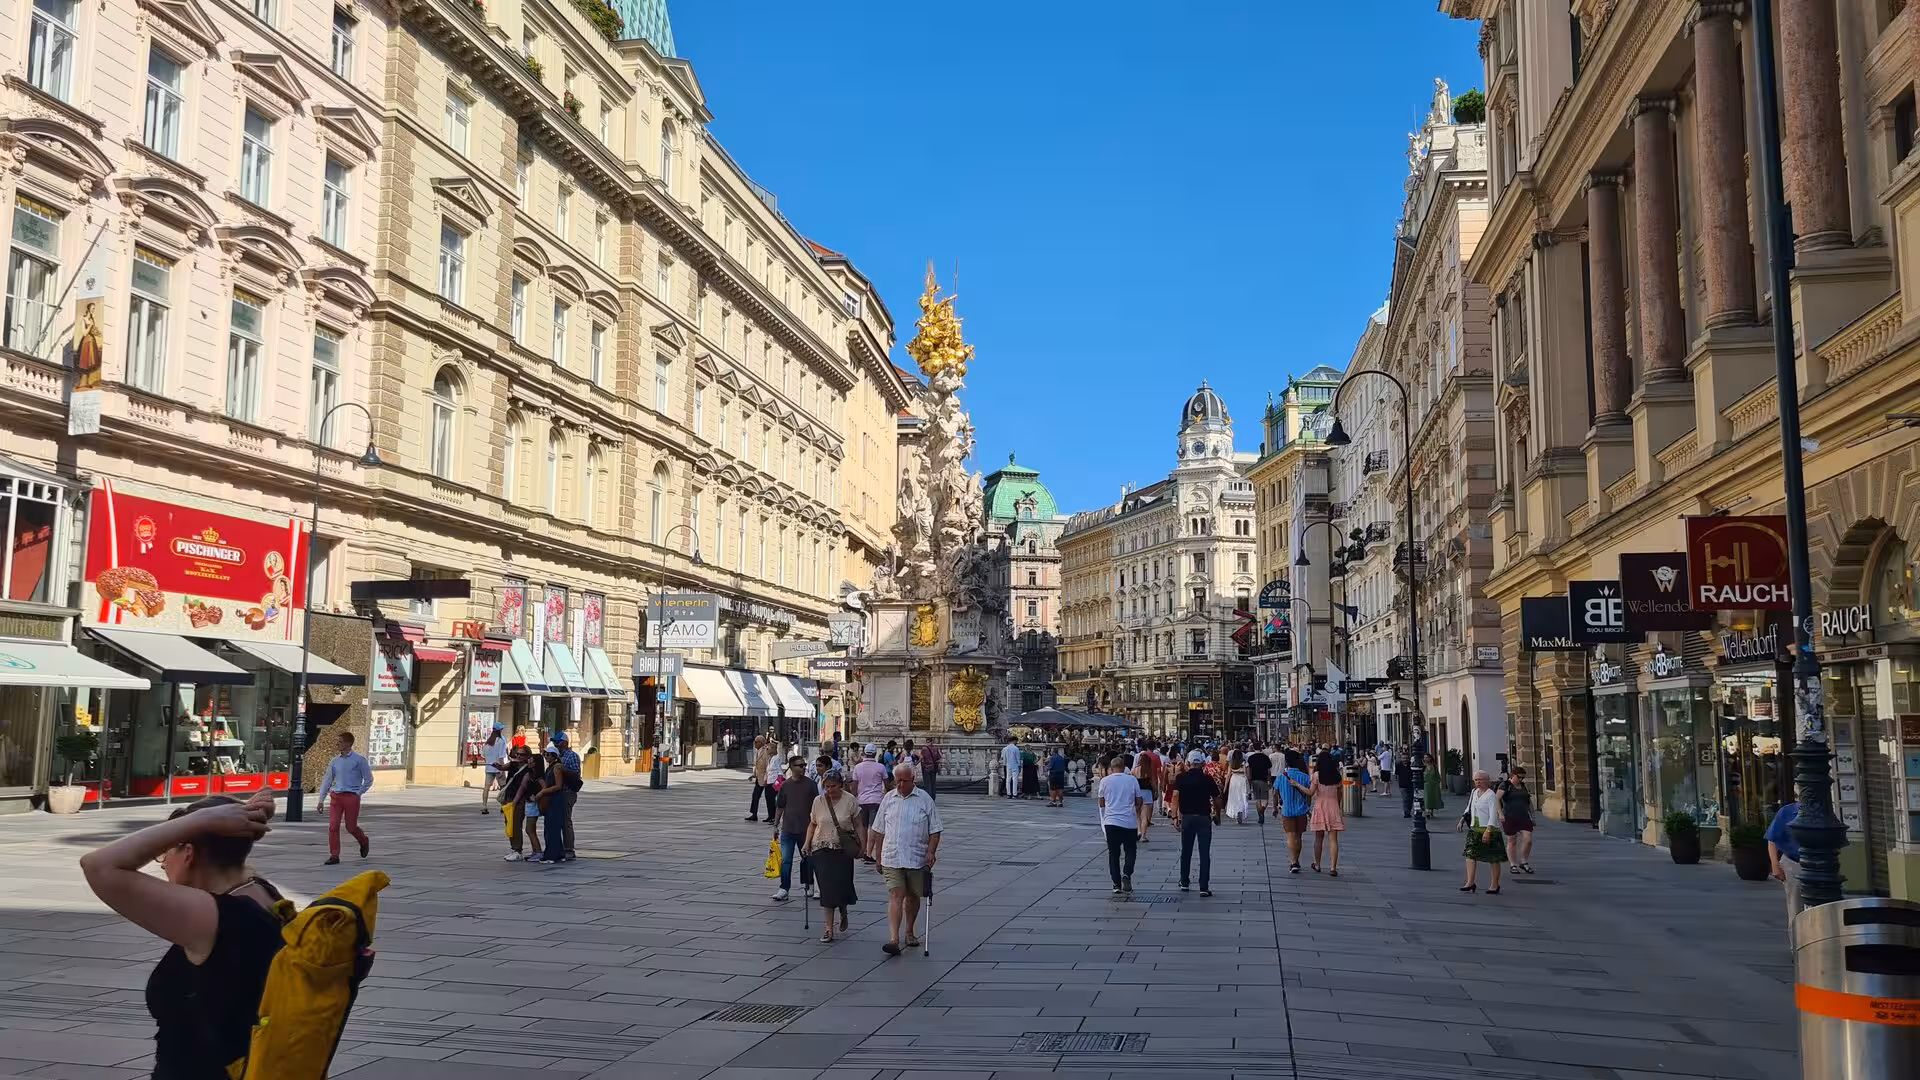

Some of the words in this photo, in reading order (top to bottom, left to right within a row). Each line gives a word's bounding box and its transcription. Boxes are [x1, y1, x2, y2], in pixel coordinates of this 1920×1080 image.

[176, 540, 241, 562] PISCHINGER
[1701, 584, 1790, 603] RAUCH
[653, 623, 708, 636] BRAMO
[1821, 603, 1872, 637] RAUCH
[1720, 623, 1778, 660] Wellendorff
